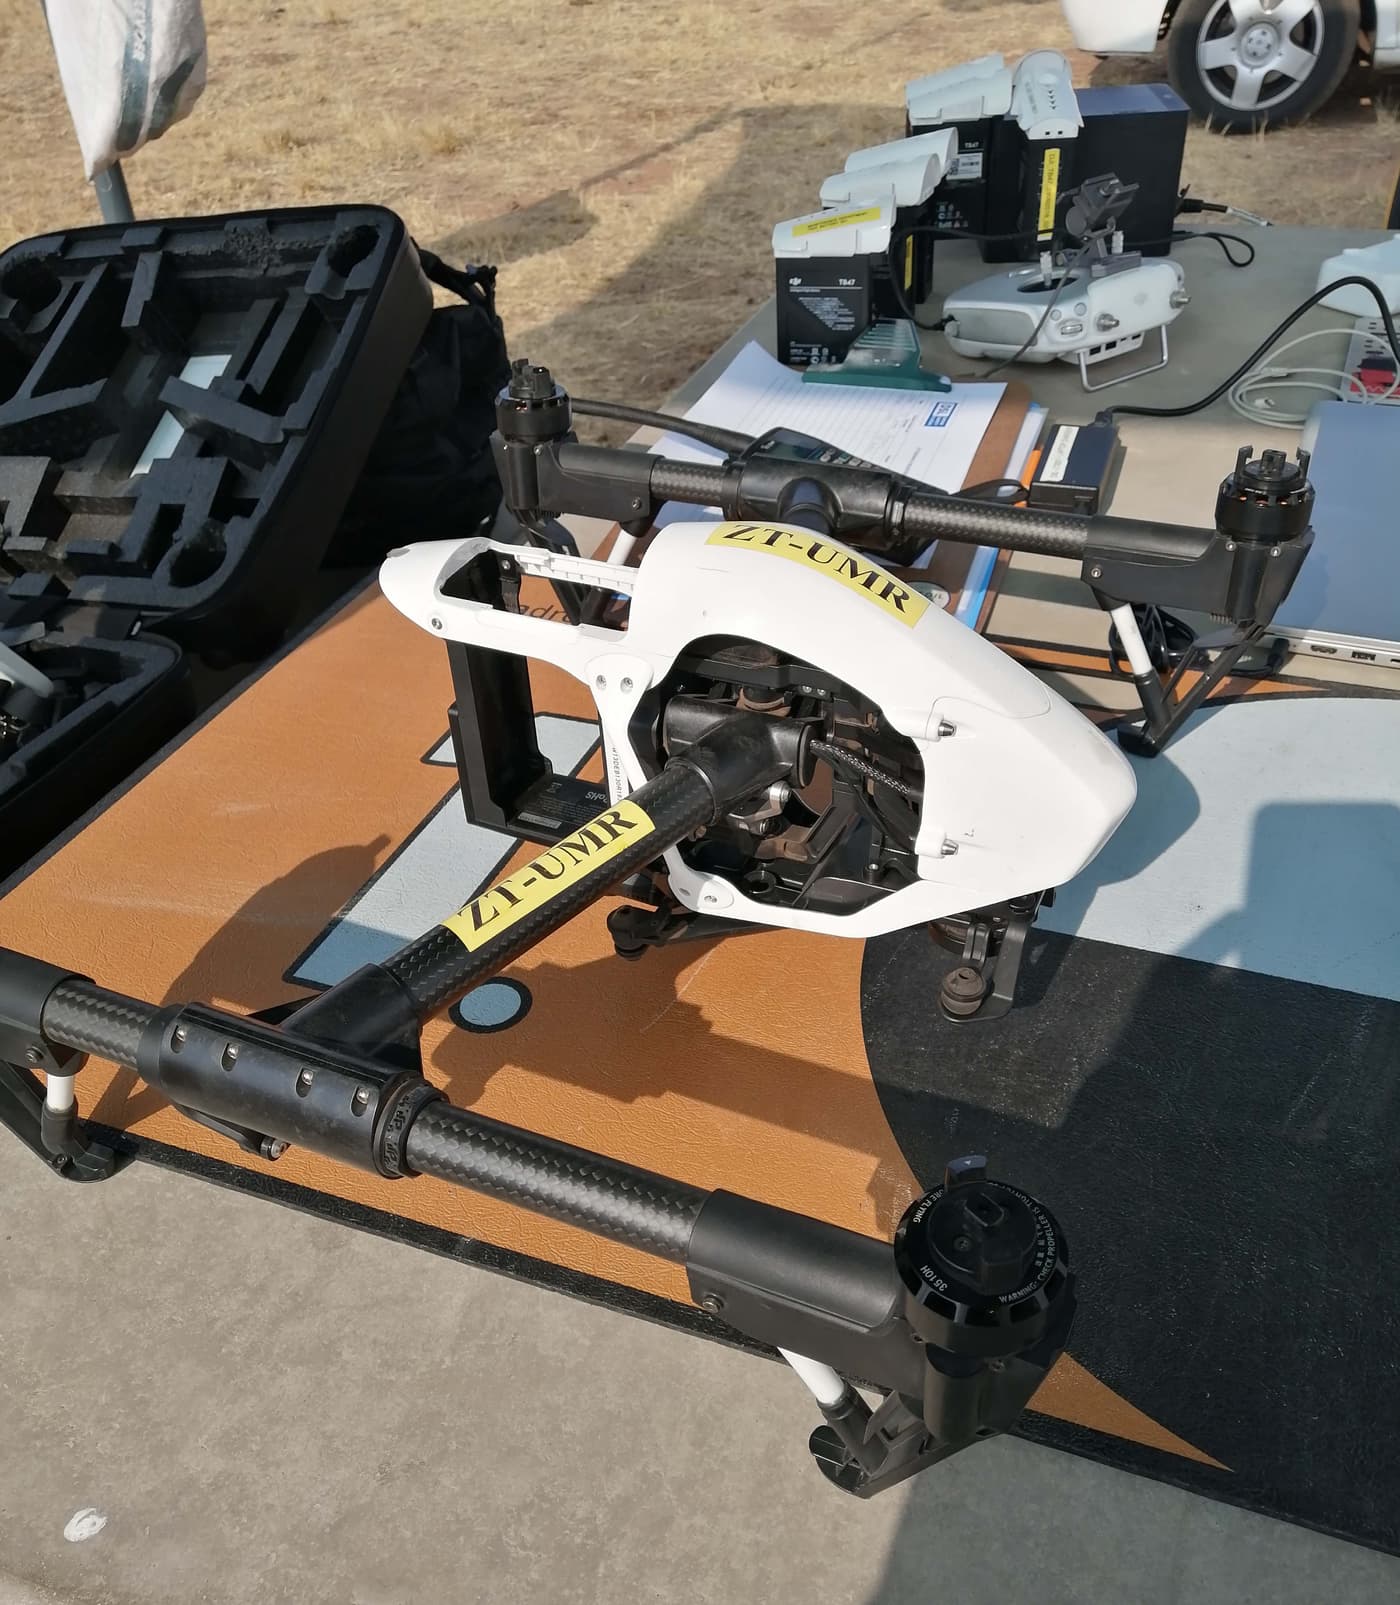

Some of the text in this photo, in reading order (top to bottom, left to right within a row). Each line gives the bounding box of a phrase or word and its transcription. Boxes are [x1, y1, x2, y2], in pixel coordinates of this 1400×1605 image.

[838, 278, 856, 286] TB47
[722, 524, 910, 613] ZT-UMR
[457, 810, 639, 932] ZT-UMR
[912, 1199, 933, 1224] FLYING
[1031, 1206, 1042, 1216] IS
[1038, 1214, 1056, 1257] PROPELLER
[919, 1264, 948, 1292] 3510H
[1036, 1257, 1054, 1282] CHECK
[998, 1281, 1038, 1304] WARNING:
